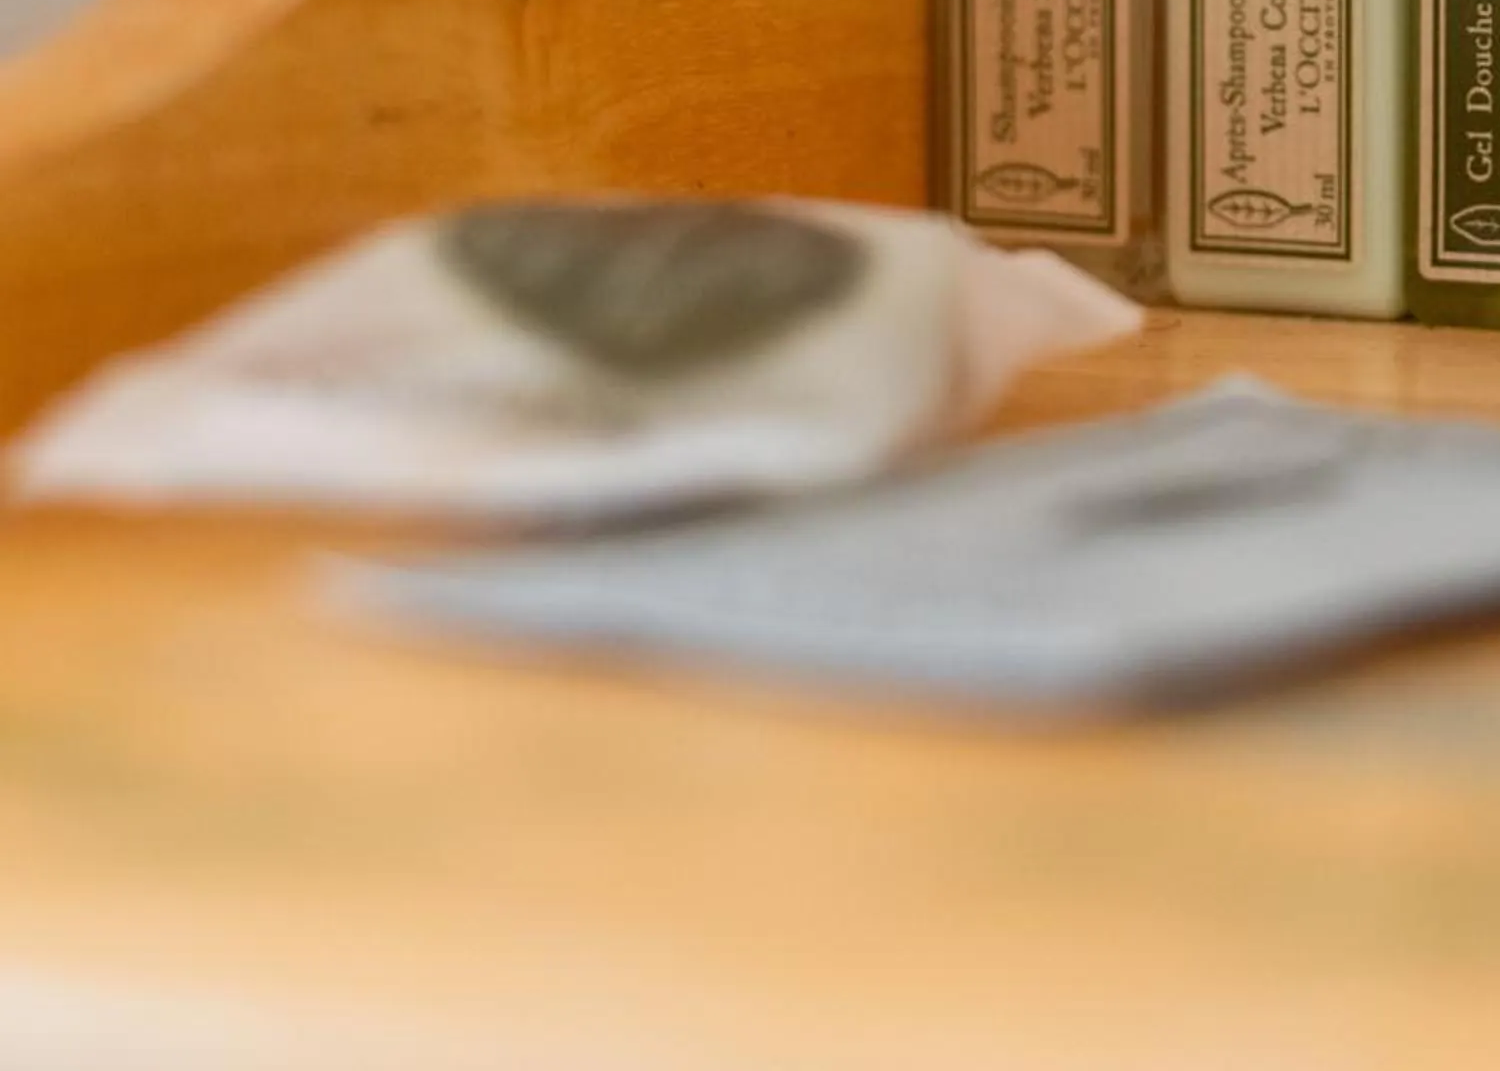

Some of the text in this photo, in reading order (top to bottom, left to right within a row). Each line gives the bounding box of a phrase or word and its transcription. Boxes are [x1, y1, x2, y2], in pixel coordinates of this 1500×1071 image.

[1261, 45, 1287, 134] Verbena
[1467, 0, 1494, 113] Douche
[1467, 131, 1495, 182] Gel
[1315, 174, 1335, 231] 30 ml
